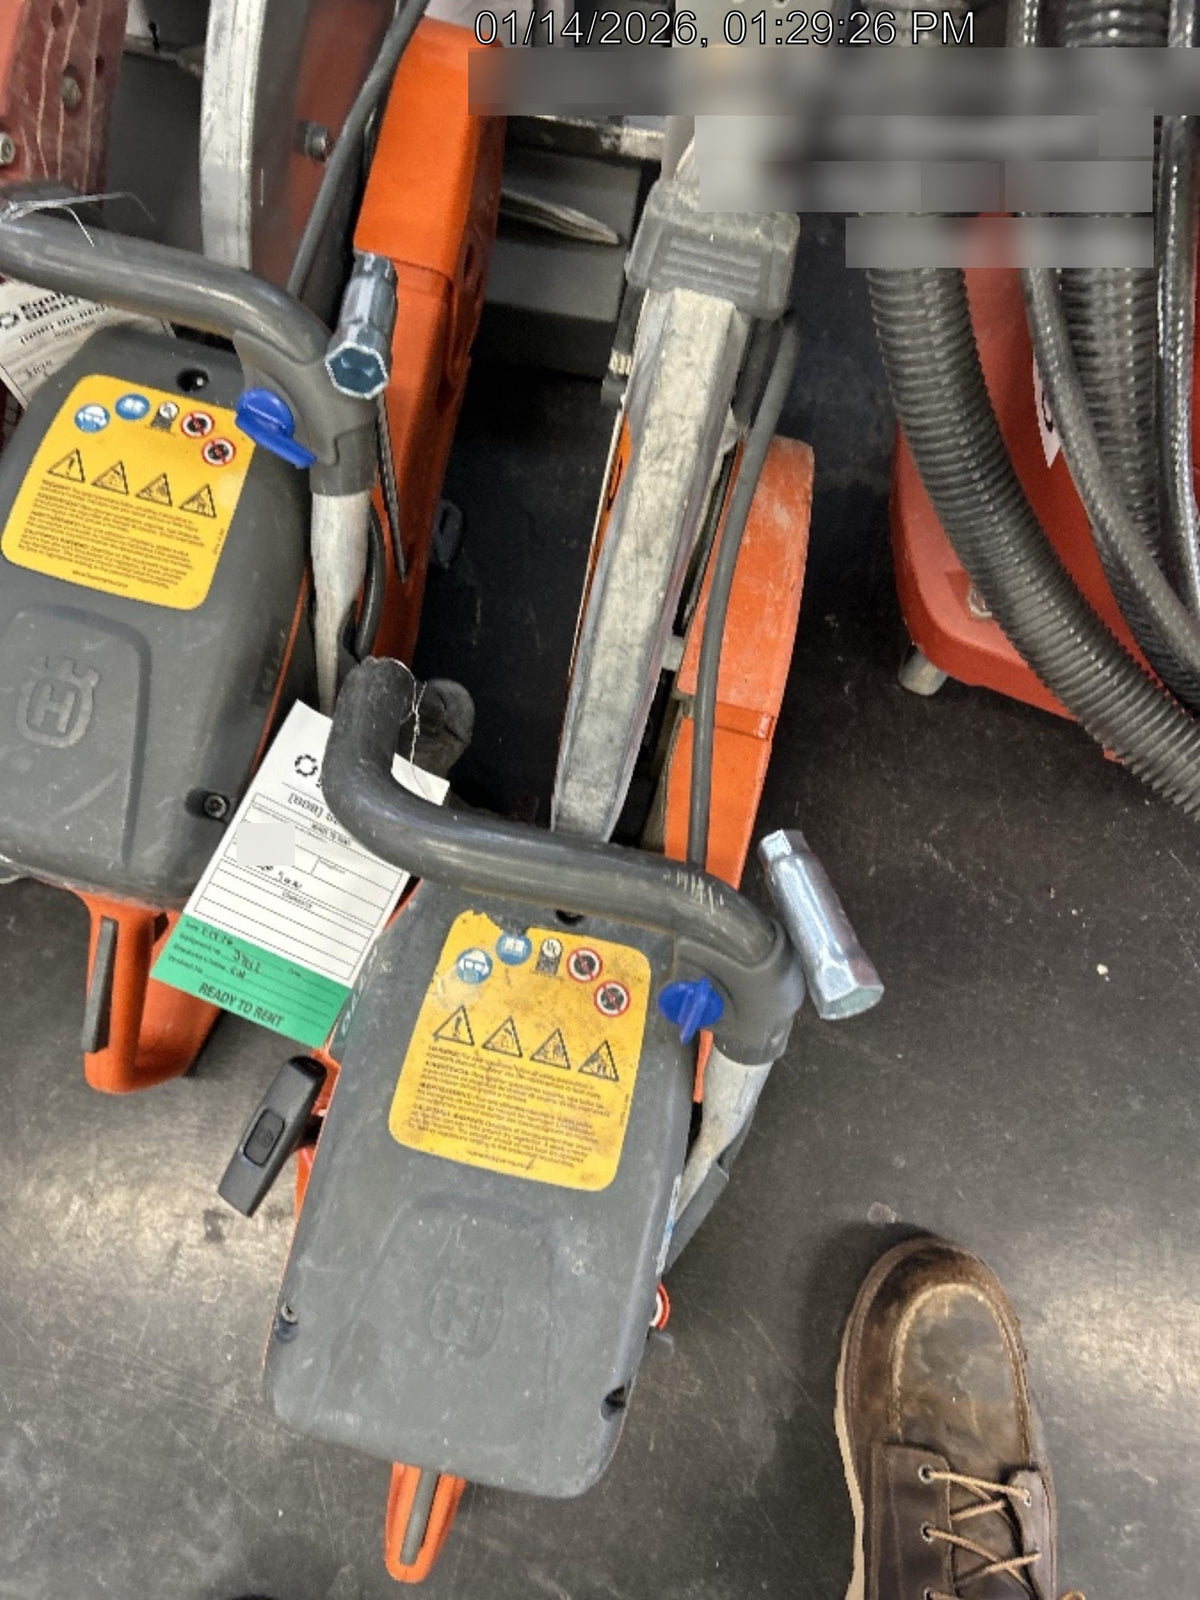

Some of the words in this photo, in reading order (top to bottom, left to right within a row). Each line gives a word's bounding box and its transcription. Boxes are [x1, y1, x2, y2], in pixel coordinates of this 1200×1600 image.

[198, 982, 237, 1007] READY
[238, 998, 253, 1015] TO
[253, 1004, 285, 1029] RENT
